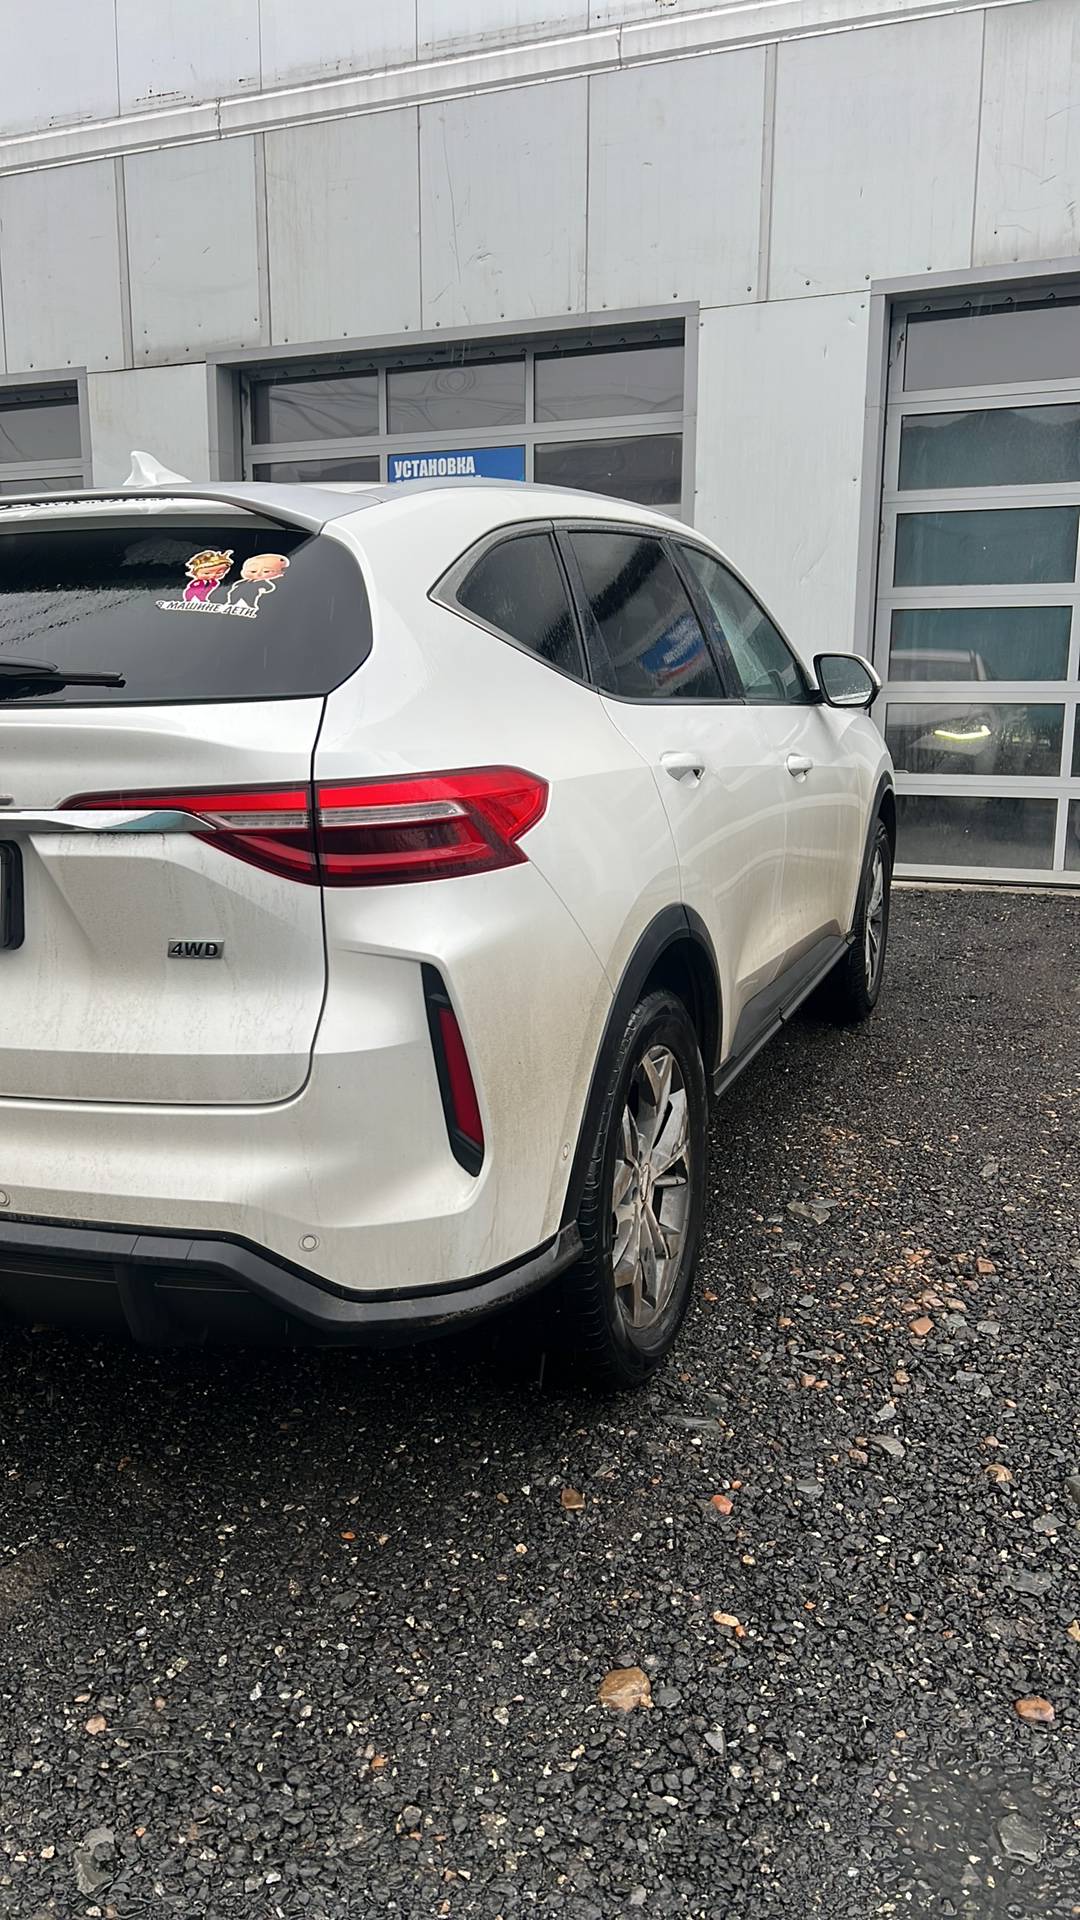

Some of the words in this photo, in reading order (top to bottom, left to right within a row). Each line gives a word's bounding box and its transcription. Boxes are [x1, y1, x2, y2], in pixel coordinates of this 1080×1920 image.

[394, 456, 476, 478] УСТАНОВКА
[166, 601, 220, 612] МАШИНЕ
[170, 942, 219, 956] 4WD
